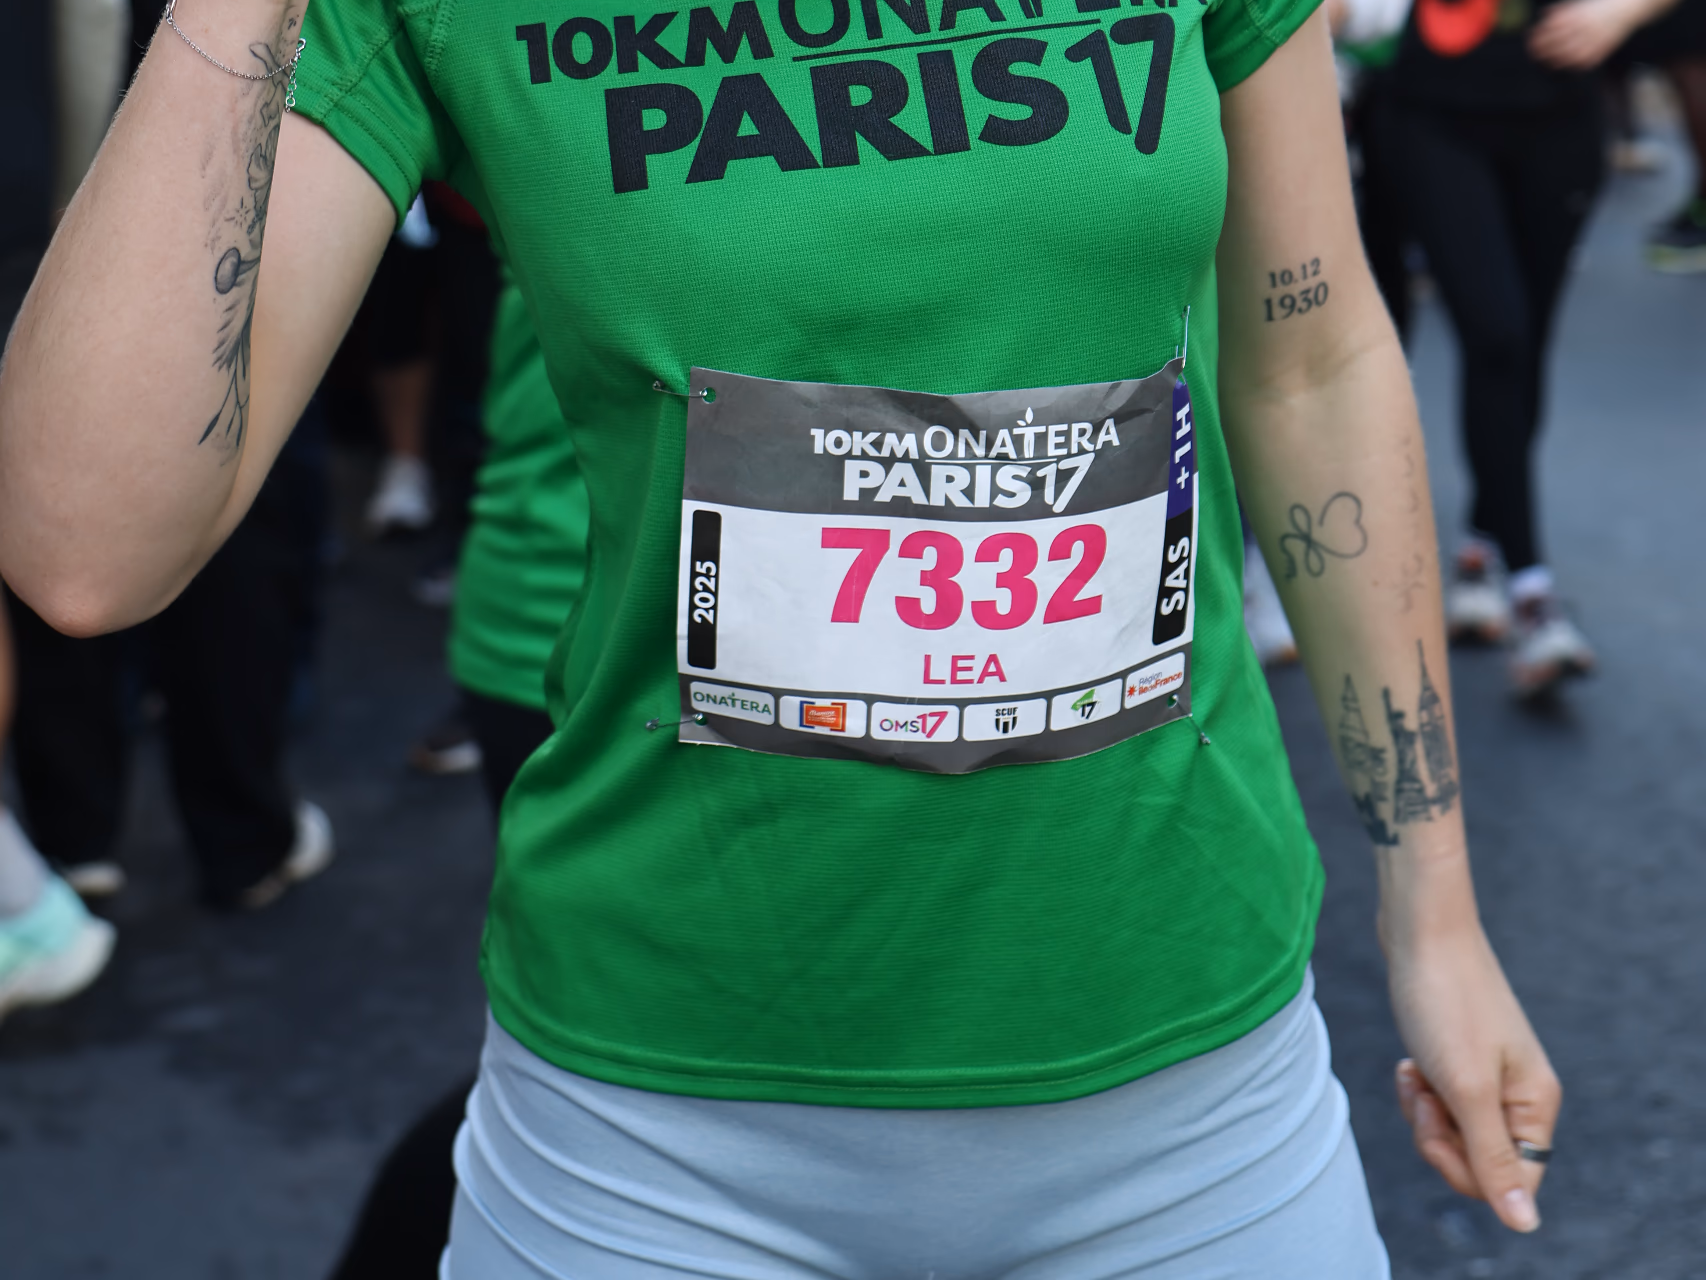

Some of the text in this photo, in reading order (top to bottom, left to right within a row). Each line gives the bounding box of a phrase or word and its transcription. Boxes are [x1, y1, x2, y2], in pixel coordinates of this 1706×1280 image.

[1269, 257, 1321, 288] 10.12
[1264, 282, 1328, 322] 1930
[693, 560, 717, 624] 2025
[821, 523, 1108, 631] 7332
[1161, 536, 1190, 615] SAS
[923, 653, 1007, 685] LEA
[693, 692, 772, 716] ONATERA
[995, 707, 1018, 717] SCUF
